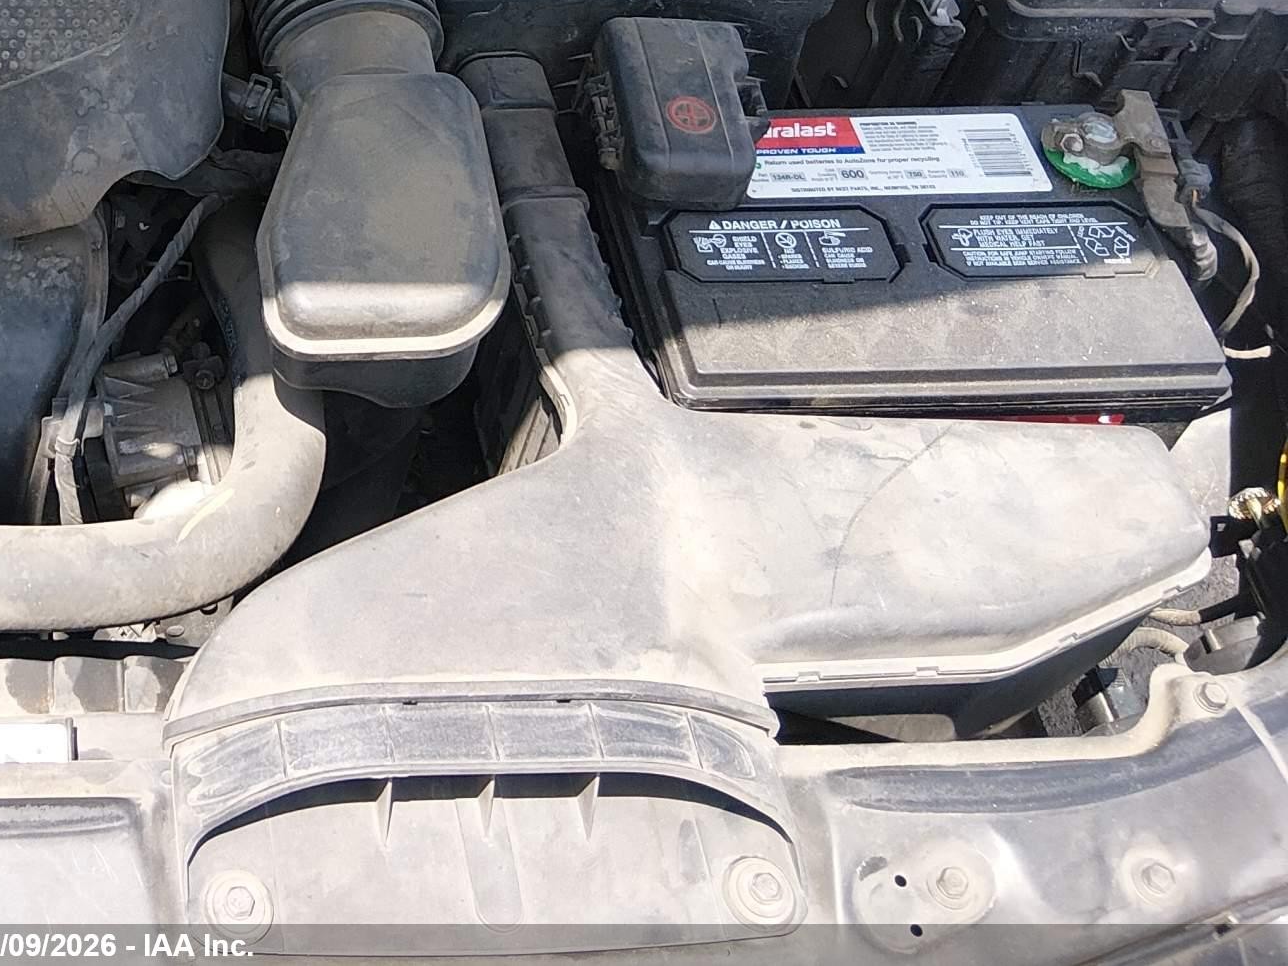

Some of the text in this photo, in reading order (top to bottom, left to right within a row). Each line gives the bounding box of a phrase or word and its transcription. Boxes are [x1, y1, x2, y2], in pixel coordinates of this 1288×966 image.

[841, 169, 865, 179] 600
[721, 218, 841, 230] DANGER / POISON
[1014, 227, 1058, 235] IMMEDIATELY
